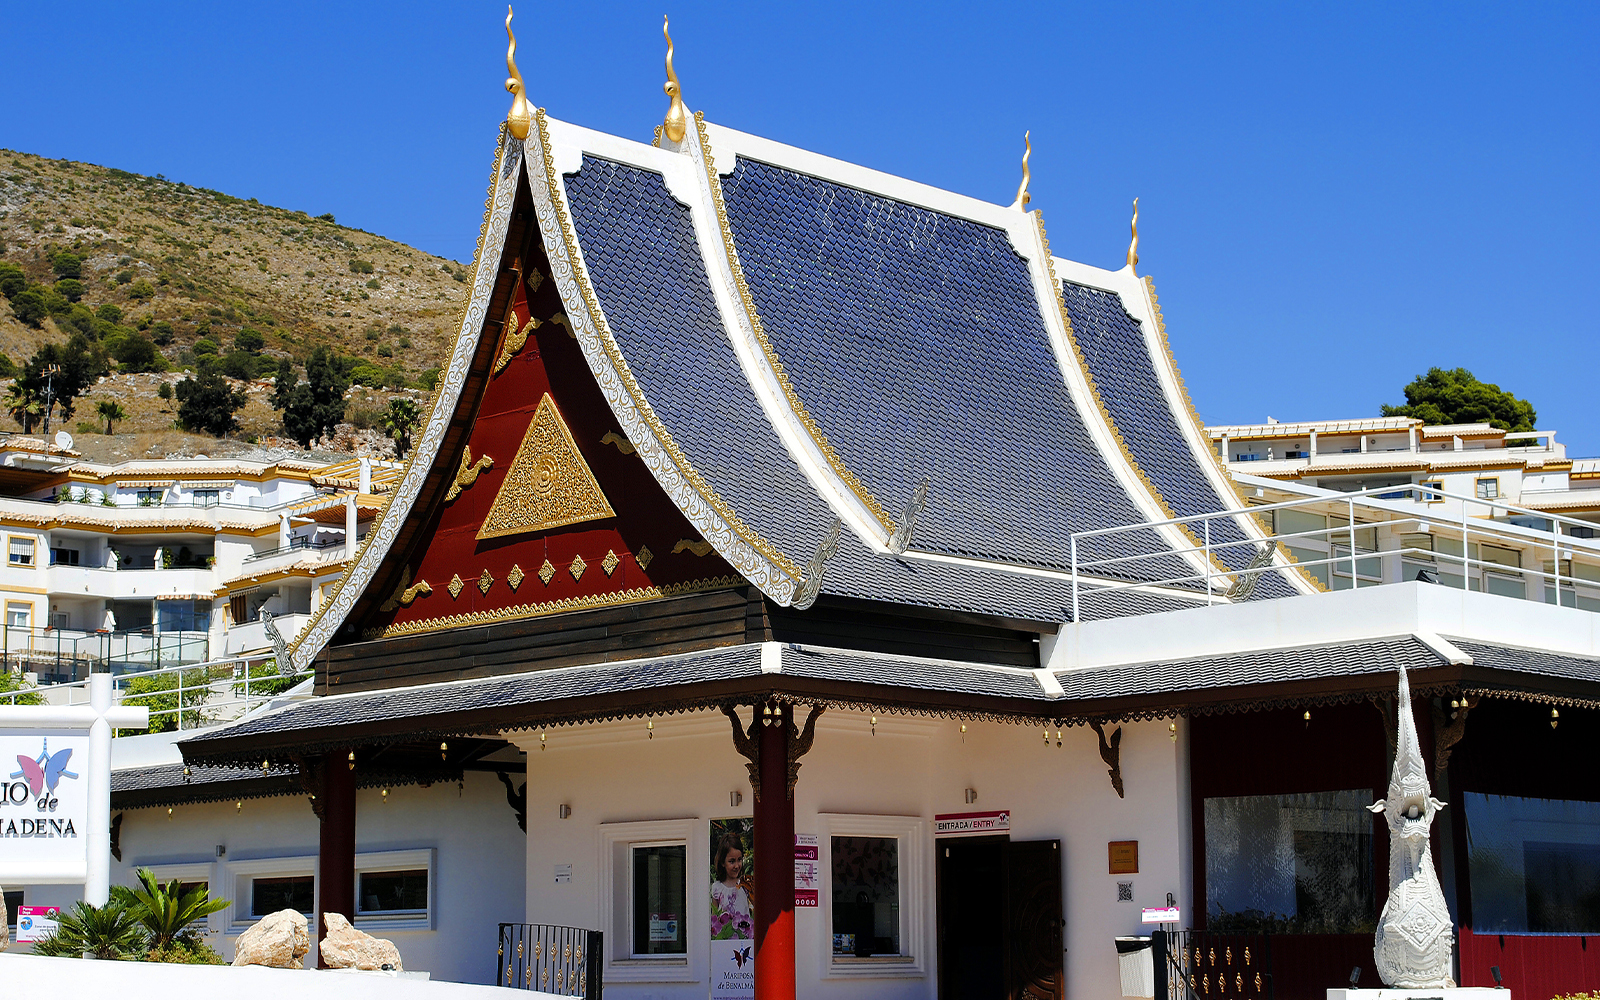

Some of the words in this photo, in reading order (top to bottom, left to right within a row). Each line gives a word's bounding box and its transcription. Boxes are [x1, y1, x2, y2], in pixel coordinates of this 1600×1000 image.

[0, 782, 29, 805] IO
[37, 792, 59, 811] de
[938, 821, 969, 830] ENTRADA
[973, 820, 995, 828] ENTRY
[717, 982, 725, 990] de
